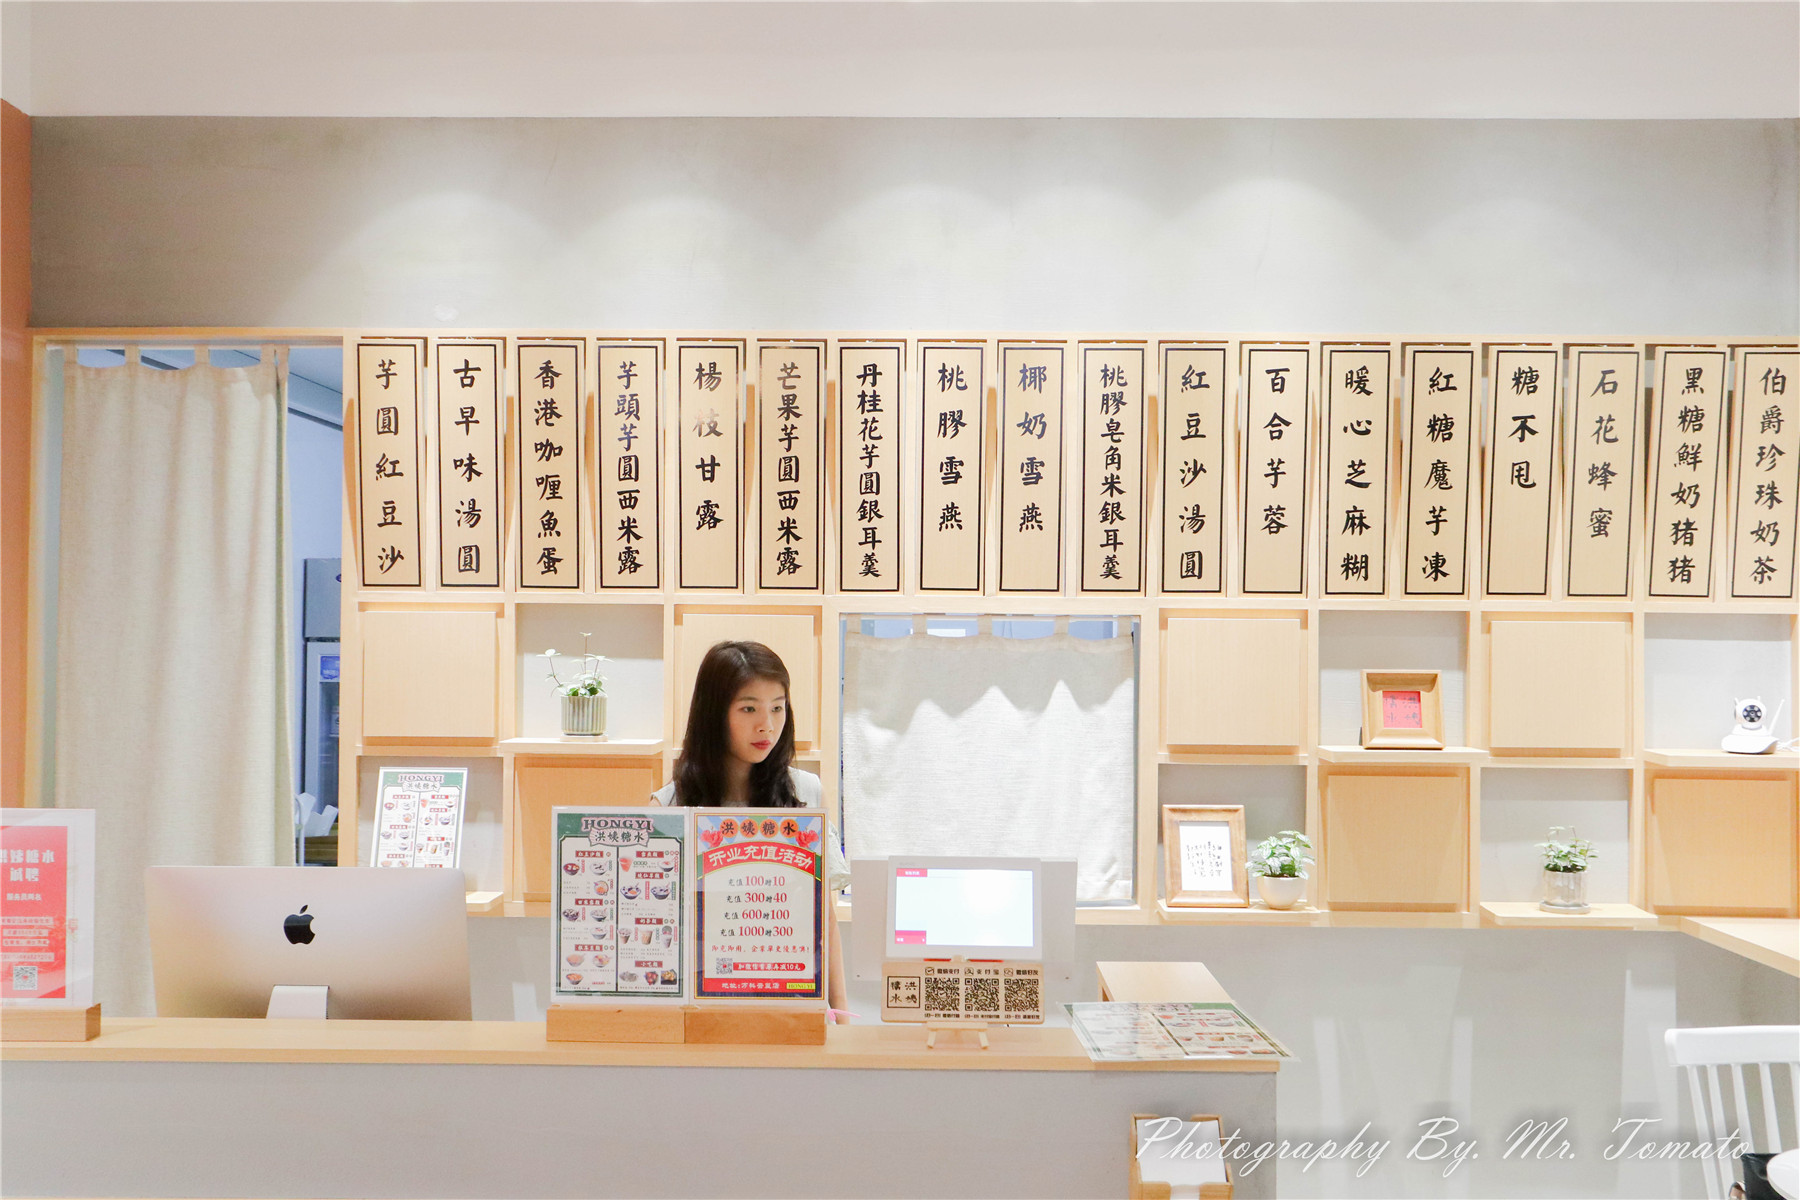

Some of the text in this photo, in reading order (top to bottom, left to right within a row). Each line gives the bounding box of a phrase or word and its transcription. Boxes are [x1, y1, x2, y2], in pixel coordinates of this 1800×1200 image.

[376, 359, 404, 574] 芋圓紅豆沙
[453, 358, 483, 574] 古早味湯圓
[534, 360, 564, 576] 香港咖喱魚蛋
[614, 361, 643, 576] 芋頭芋圓西米露
[693, 362, 724, 531] 楊枝甘露
[776, 362, 803, 576] 芒果芋圓西米露
[856, 363, 884, 577] 丹桂花芋圓銀耳羹
[937, 363, 968, 532] 桃膠雪燕
[1016, 363, 1047, 532] 椰奶雪燕
[1098, 364, 1128, 580] 桃膠皂角米銀耳羹
[1179, 364, 1210, 580] 紅豆沙湯圓
[1261, 368, 1292, 535] 百合芋蓉
[1341, 365, 1373, 581] 暖心芝麻糊
[1422, 367, 1457, 582] 紅糖魔芋凍
[1508, 366, 1539, 489] 糖不甩
[1587, 369, 1619, 538] 石花蜂蜜
[1750, 368, 1786, 584] 伯爵珍珠奶茶
[584, 819, 652, 830] HONGYI
[595, 831, 645, 842] 洪姨糖水
[708, 845, 812, 869] 开业充值活动
[721, 821, 796, 835] 洪姨糖水
